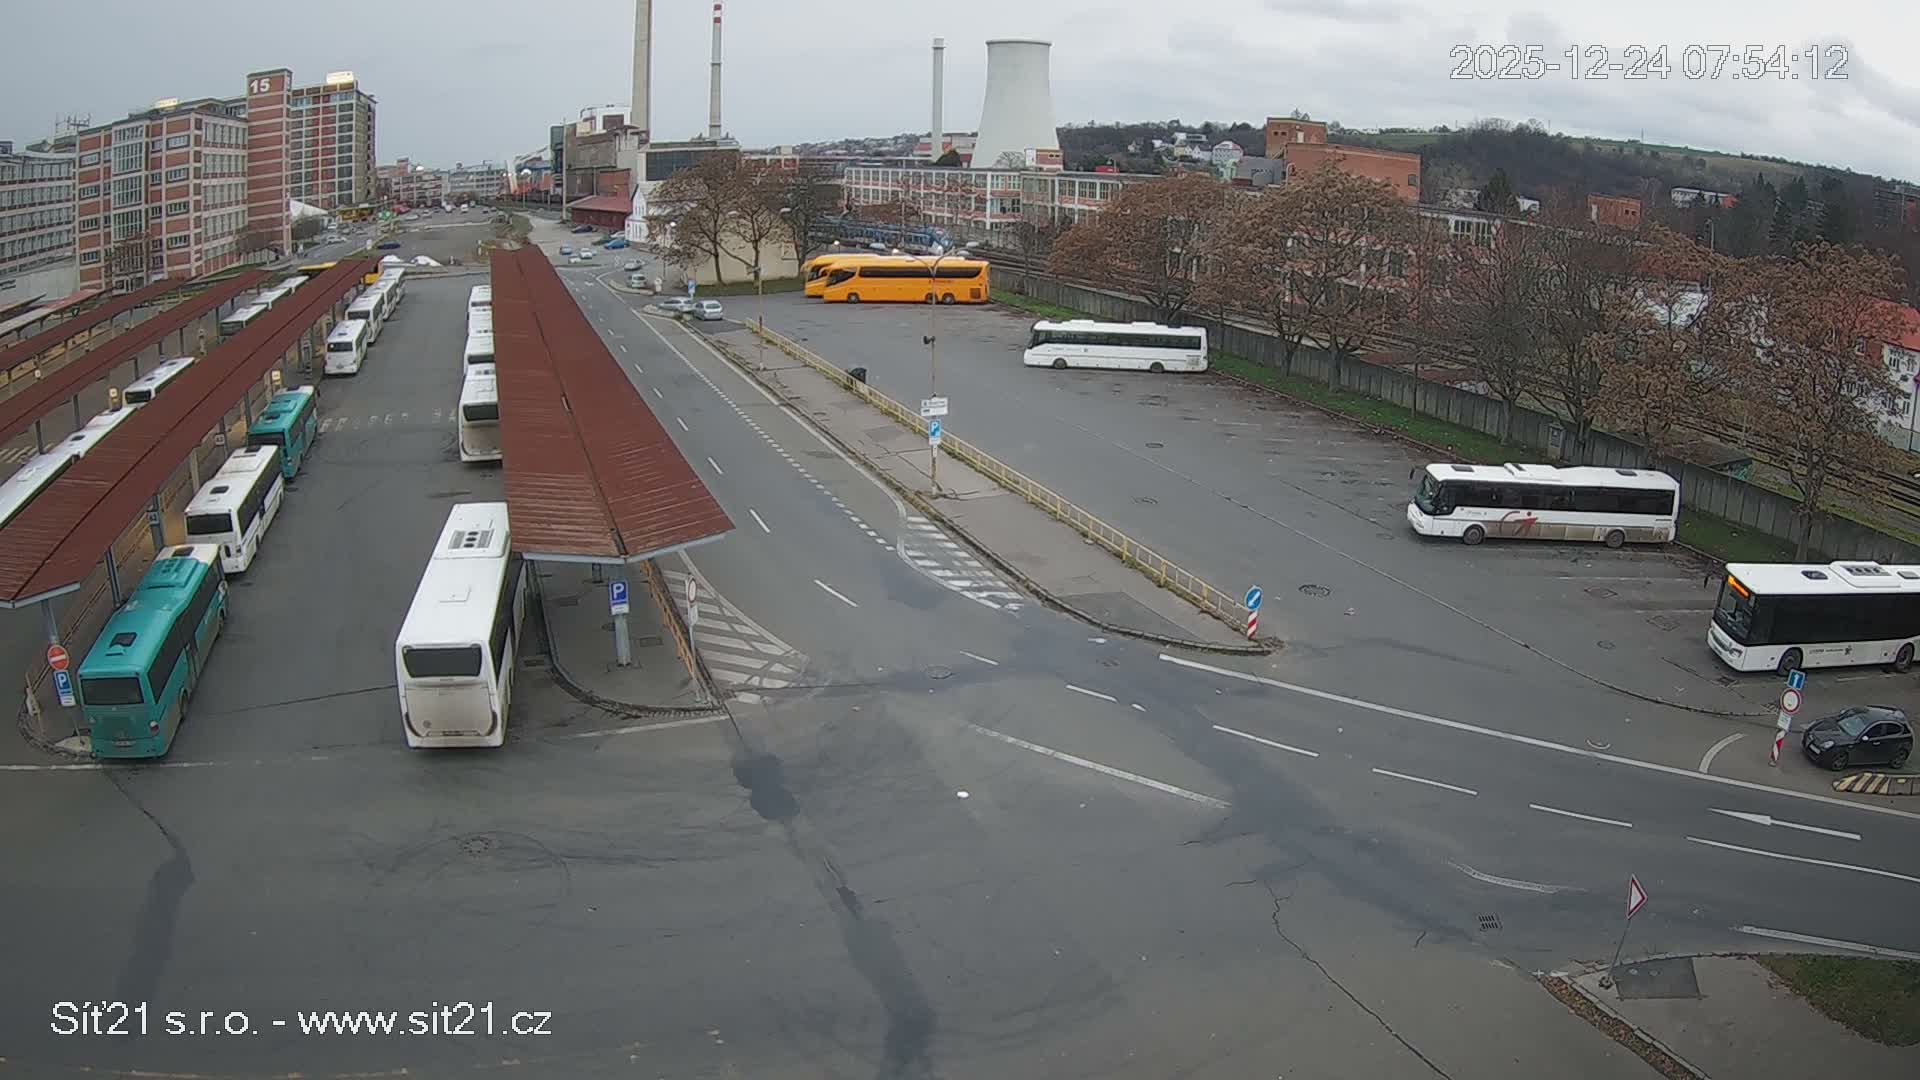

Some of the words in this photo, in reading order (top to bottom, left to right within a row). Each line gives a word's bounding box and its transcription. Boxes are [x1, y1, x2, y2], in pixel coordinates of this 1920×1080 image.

[250, 78, 270, 93] 15
[613, 583, 624, 599] P
[58, 673, 67, 688] P
